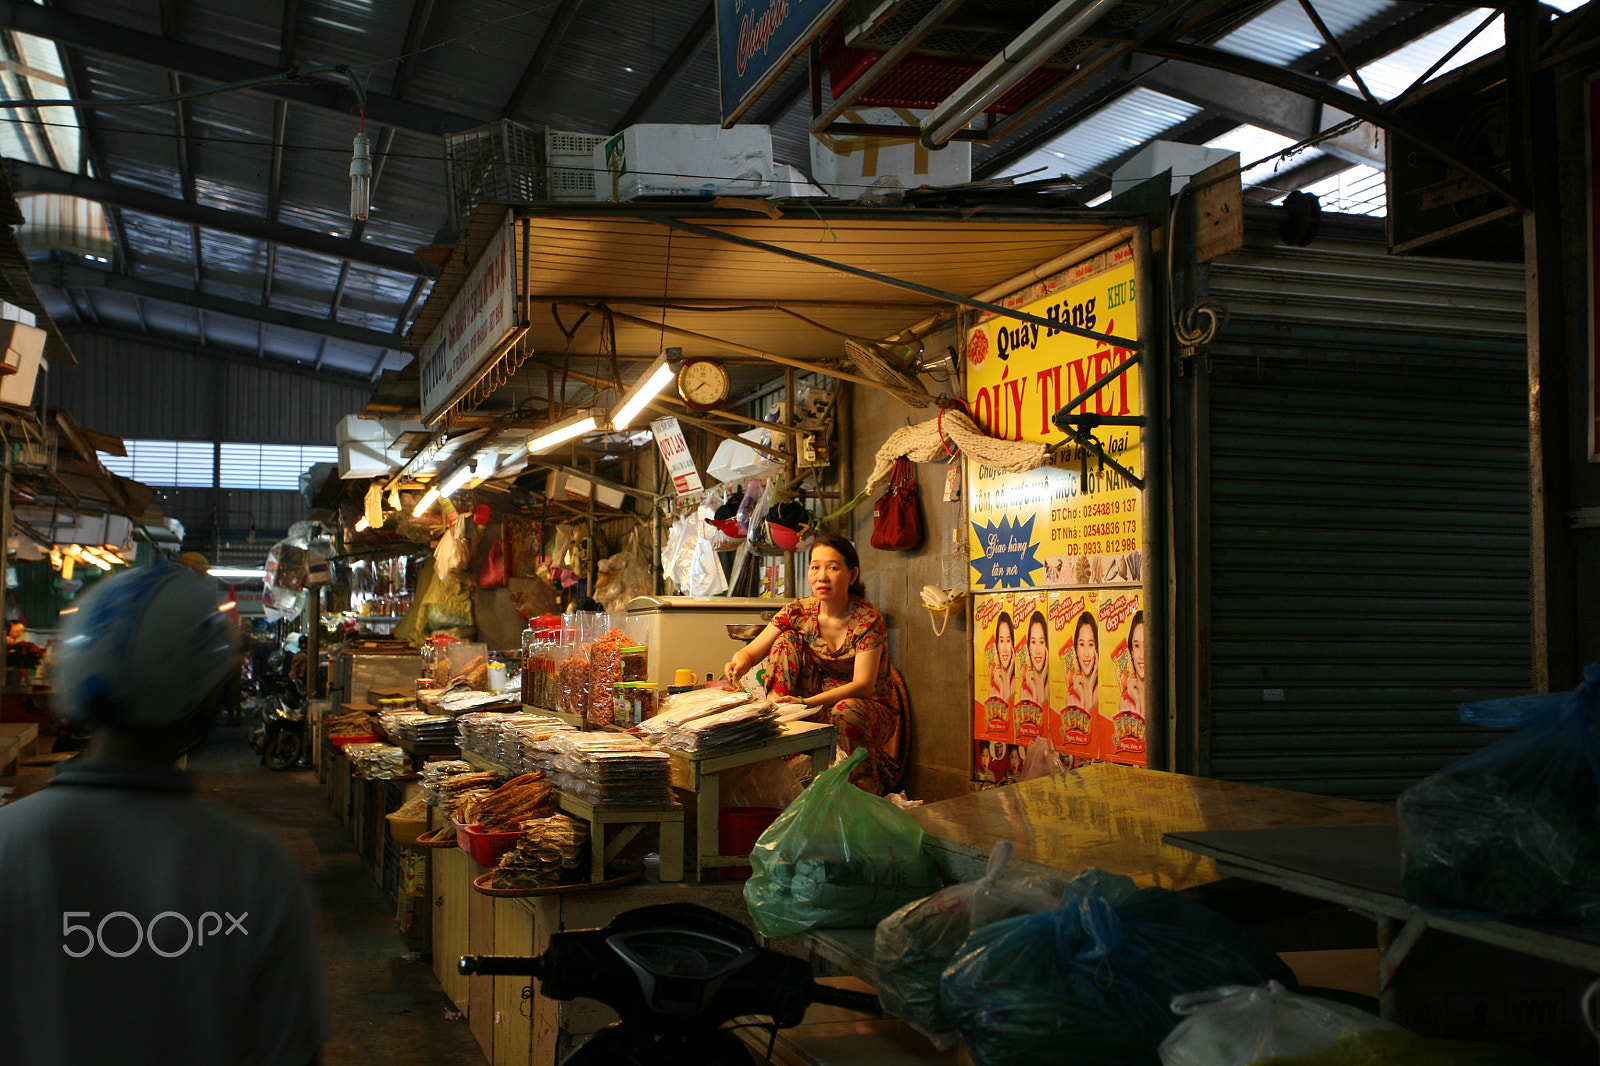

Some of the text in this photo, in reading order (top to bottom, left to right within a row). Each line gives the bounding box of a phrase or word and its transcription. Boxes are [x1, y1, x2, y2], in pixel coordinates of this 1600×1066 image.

[1107, 282, 1127, 309] KHU
[1046, 297, 1096, 337] Hàng
[1037, 319, 1134, 436] TUYẾT
[1061, 444, 1072, 463] và
[1108, 431, 1129, 456] loại
[1055, 472, 1077, 503] MỰC
[1081, 466, 1101, 499] ỘT
[1122, 498, 1137, 513] 137
[1122, 519, 1137, 534] 173
[986, 533, 1028, 560] Giao hàng
[1105, 539, 1120, 553] 812
[1121, 537, 1136, 552] 986
[991, 562, 1019, 580] tận nơi
